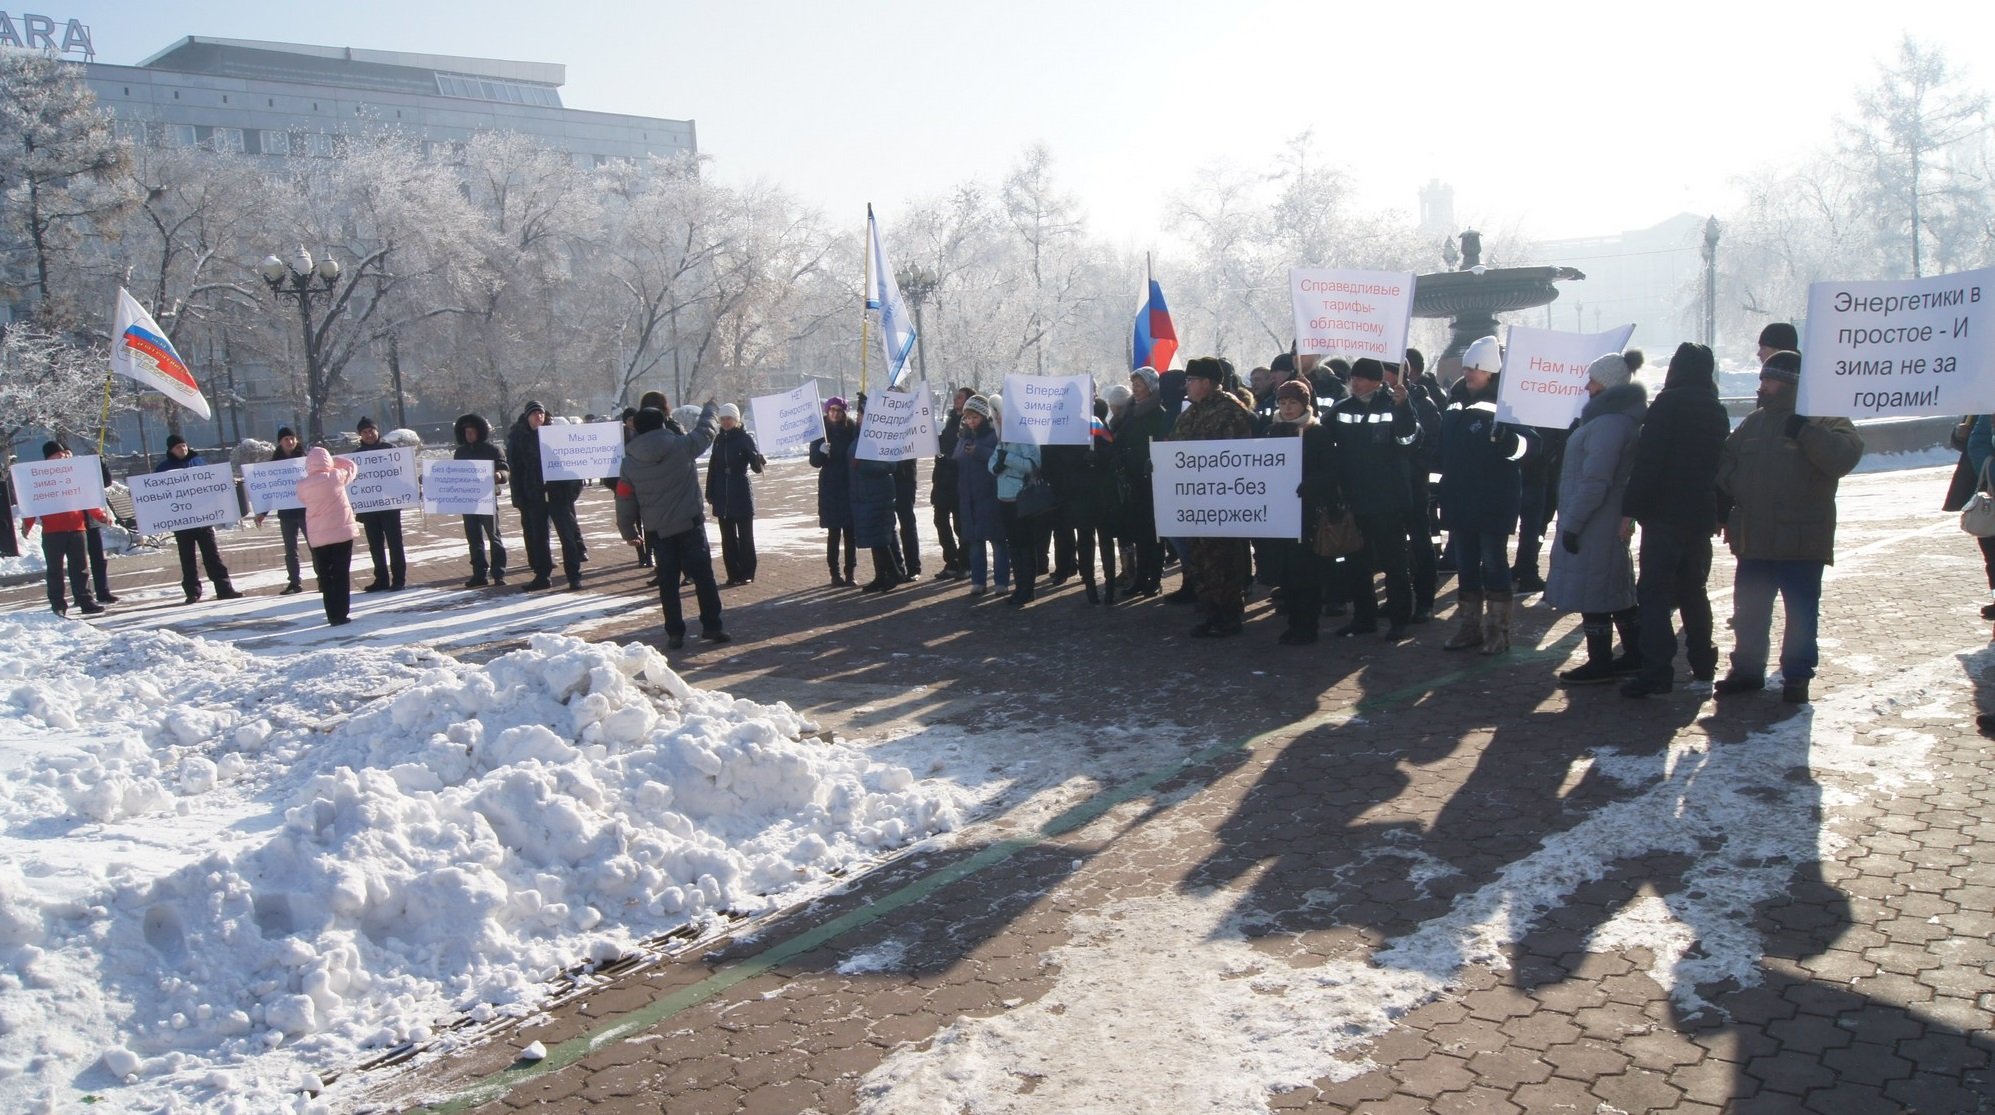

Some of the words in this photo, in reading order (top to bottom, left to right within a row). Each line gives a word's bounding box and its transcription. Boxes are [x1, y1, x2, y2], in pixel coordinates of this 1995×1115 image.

[1300, 278, 1401, 297] Справедливые
[1322, 300, 1376, 315] тарифы-
[1833, 288, 1965, 317] Энергетики
[1970, 286, 1982, 303] в
[1309, 316, 1385, 337] областному
[1838, 325, 1933, 349] простое
[1953, 316, 1969, 339] И
[1302, 338, 1388, 355] предприятию!
[1529, 356, 1565, 374] Нам
[1834, 358, 1893, 376] зима
[1901, 358, 1927, 375] не
[1932, 355, 1957, 374] за
[1024, 401, 1052, 411] зима
[1853, 385, 1940, 413] горами!
[568, 433, 585, 442] Мы
[587, 433, 598, 441] за
[364, 452, 401, 465] лет-10
[552, 444, 617, 456] справедливое
[547, 458, 588, 470] деление
[1174, 449, 1286, 473] Заработная
[31, 465, 73, 477] Впереди
[253, 470, 267, 479] Не
[32, 479, 57, 489] зима
[143, 472, 190, 489] Каждый
[192, 471, 216, 483] год-
[249, 482, 267, 491] без
[1175, 476, 1267, 496] плата-без
[32, 491, 59, 501] денег
[61, 487, 81, 497] нет!
[135, 490, 173, 504] новый
[175, 483, 231, 499] директор.
[350, 485, 359, 496] С
[360, 484, 383, 494] кого
[170, 502, 193, 513] Это
[1176, 504, 1268, 526] задержек!
[153, 509, 225, 530] нормально!?
